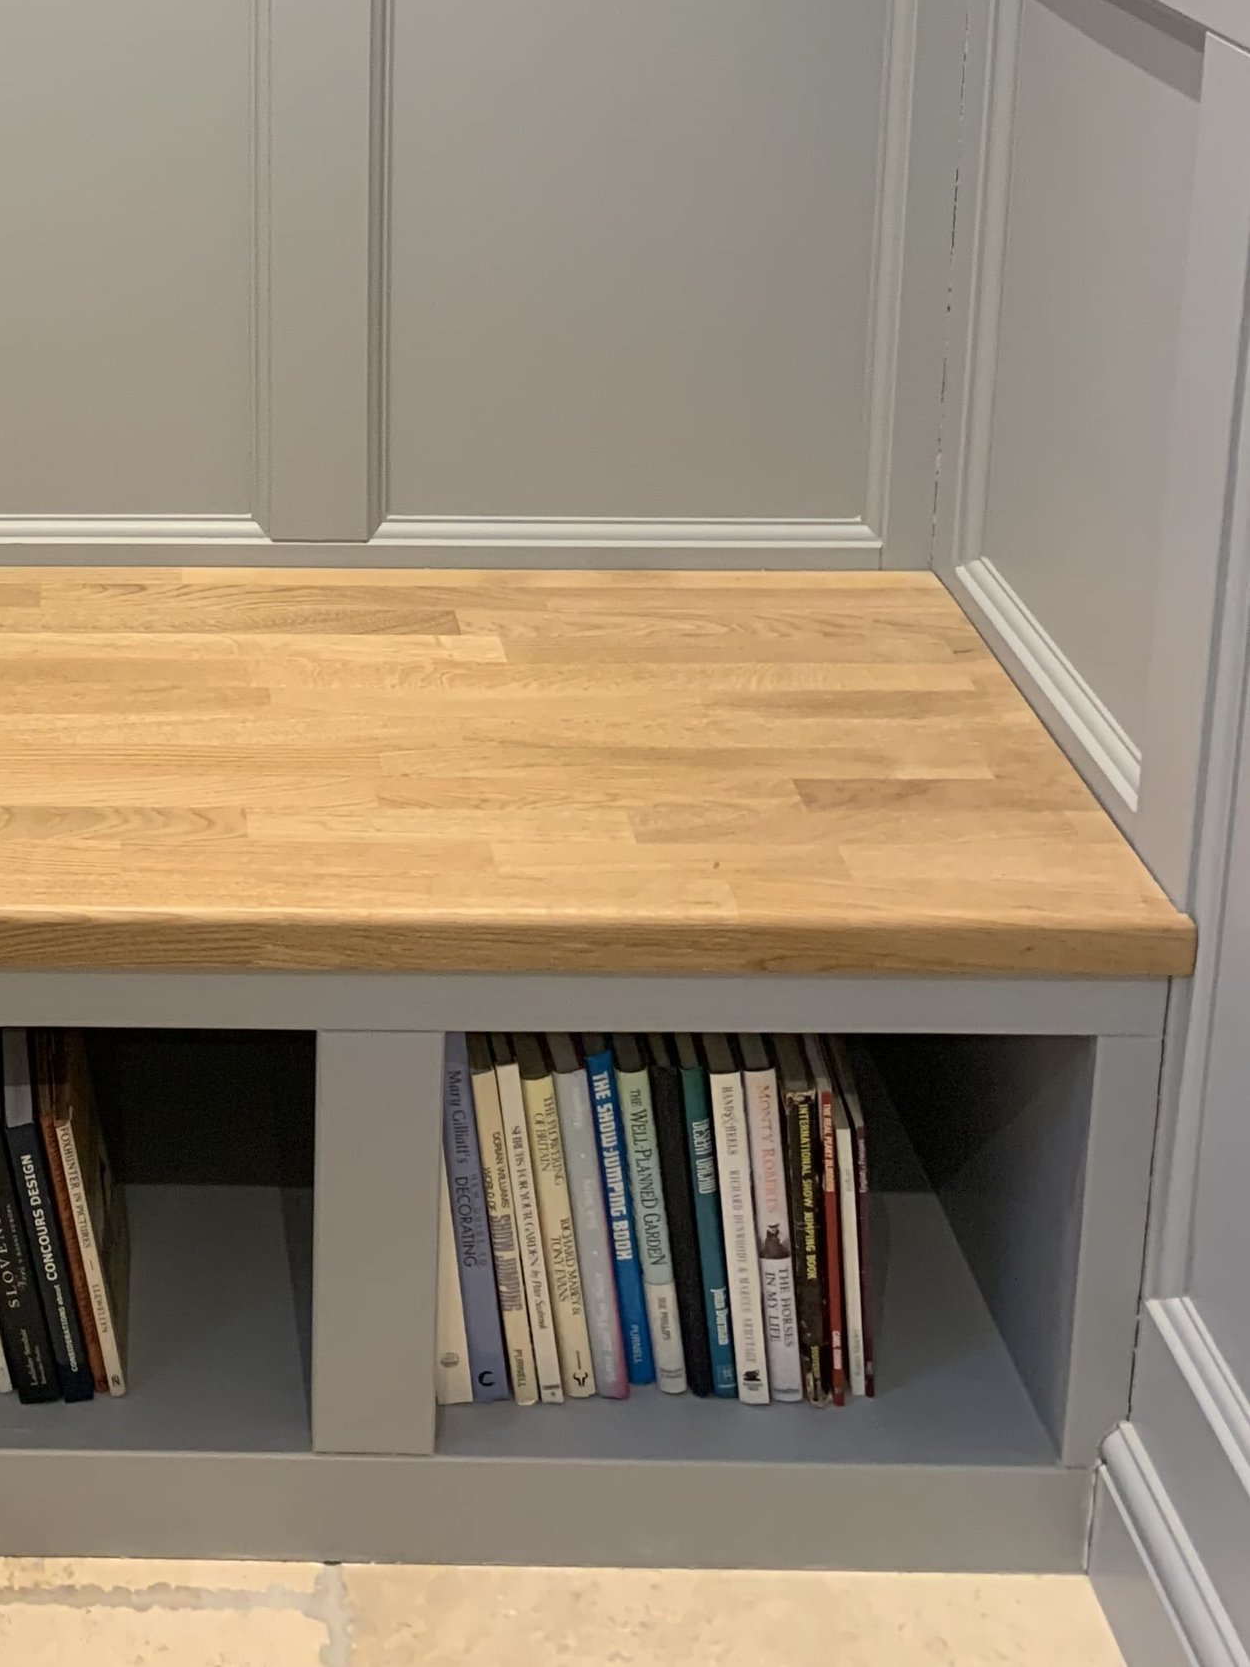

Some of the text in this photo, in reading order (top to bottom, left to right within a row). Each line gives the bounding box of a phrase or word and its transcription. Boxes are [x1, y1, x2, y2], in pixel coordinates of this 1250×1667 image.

[448, 1069, 471, 1165] Mary Gilliatt's
[543, 1096, 565, 1186] THE FLOWERING
[725, 1125, 739, 1156] HEELS
[823, 1103, 832, 1116] THE
[823, 1116, 833, 1134] REAL
[492, 1131, 505, 1165] DORIAN
[511, 1125, 526, 1166] SHRUBS
[533, 1112, 552, 1172] OF BRITAIN
[592, 1070, 612, 1101] THE
[612, 1220, 633, 1261] BOOK
[692, 1117, 717, 1195] DESERT ORCHID
[756, 1085, 779, 1214] MONTY ROBERTS
[824, 1135, 835, 1158] PEAKY
[20, 1154, 42, 1207] DESIGN
[482, 1166, 497, 1212] WORLD OF
[516, 1168, 529, 1190] FOR
[519, 1191, 534, 1221] YOUR
[630, 1088, 668, 1266] THE WELL-PLANNED GARDEN
[729, 1169, 744, 1211] RICHARD
[798, 1103, 818, 1280] INTERNATIONAL SHOW JUMPING BOOK
[32, 1208, 58, 1282] CONCOURS
[60, 1126, 109, 1334] FOXHUNTER IN PICTURES LLEWELLYN
[454, 1176, 478, 1268] DECORATING
[524, 1221, 540, 1267] GARDEN
[490, 1214, 523, 1312] SHOW JUMPING
[550, 1235, 570, 1302] TONY EVANS
[560, 1217, 582, 1306] RICHARD MABEY
[53, 1284, 64, 1306] about
[765, 1271, 782, 1342] IN MY LIFE
[778, 1266, 795, 1348] THE HORSES
[58, 1306, 79, 1373] CONSIDERATIONS
[514, 1348, 527, 1388] PURNELL
[630, 1323, 643, 1364] PURNELL
